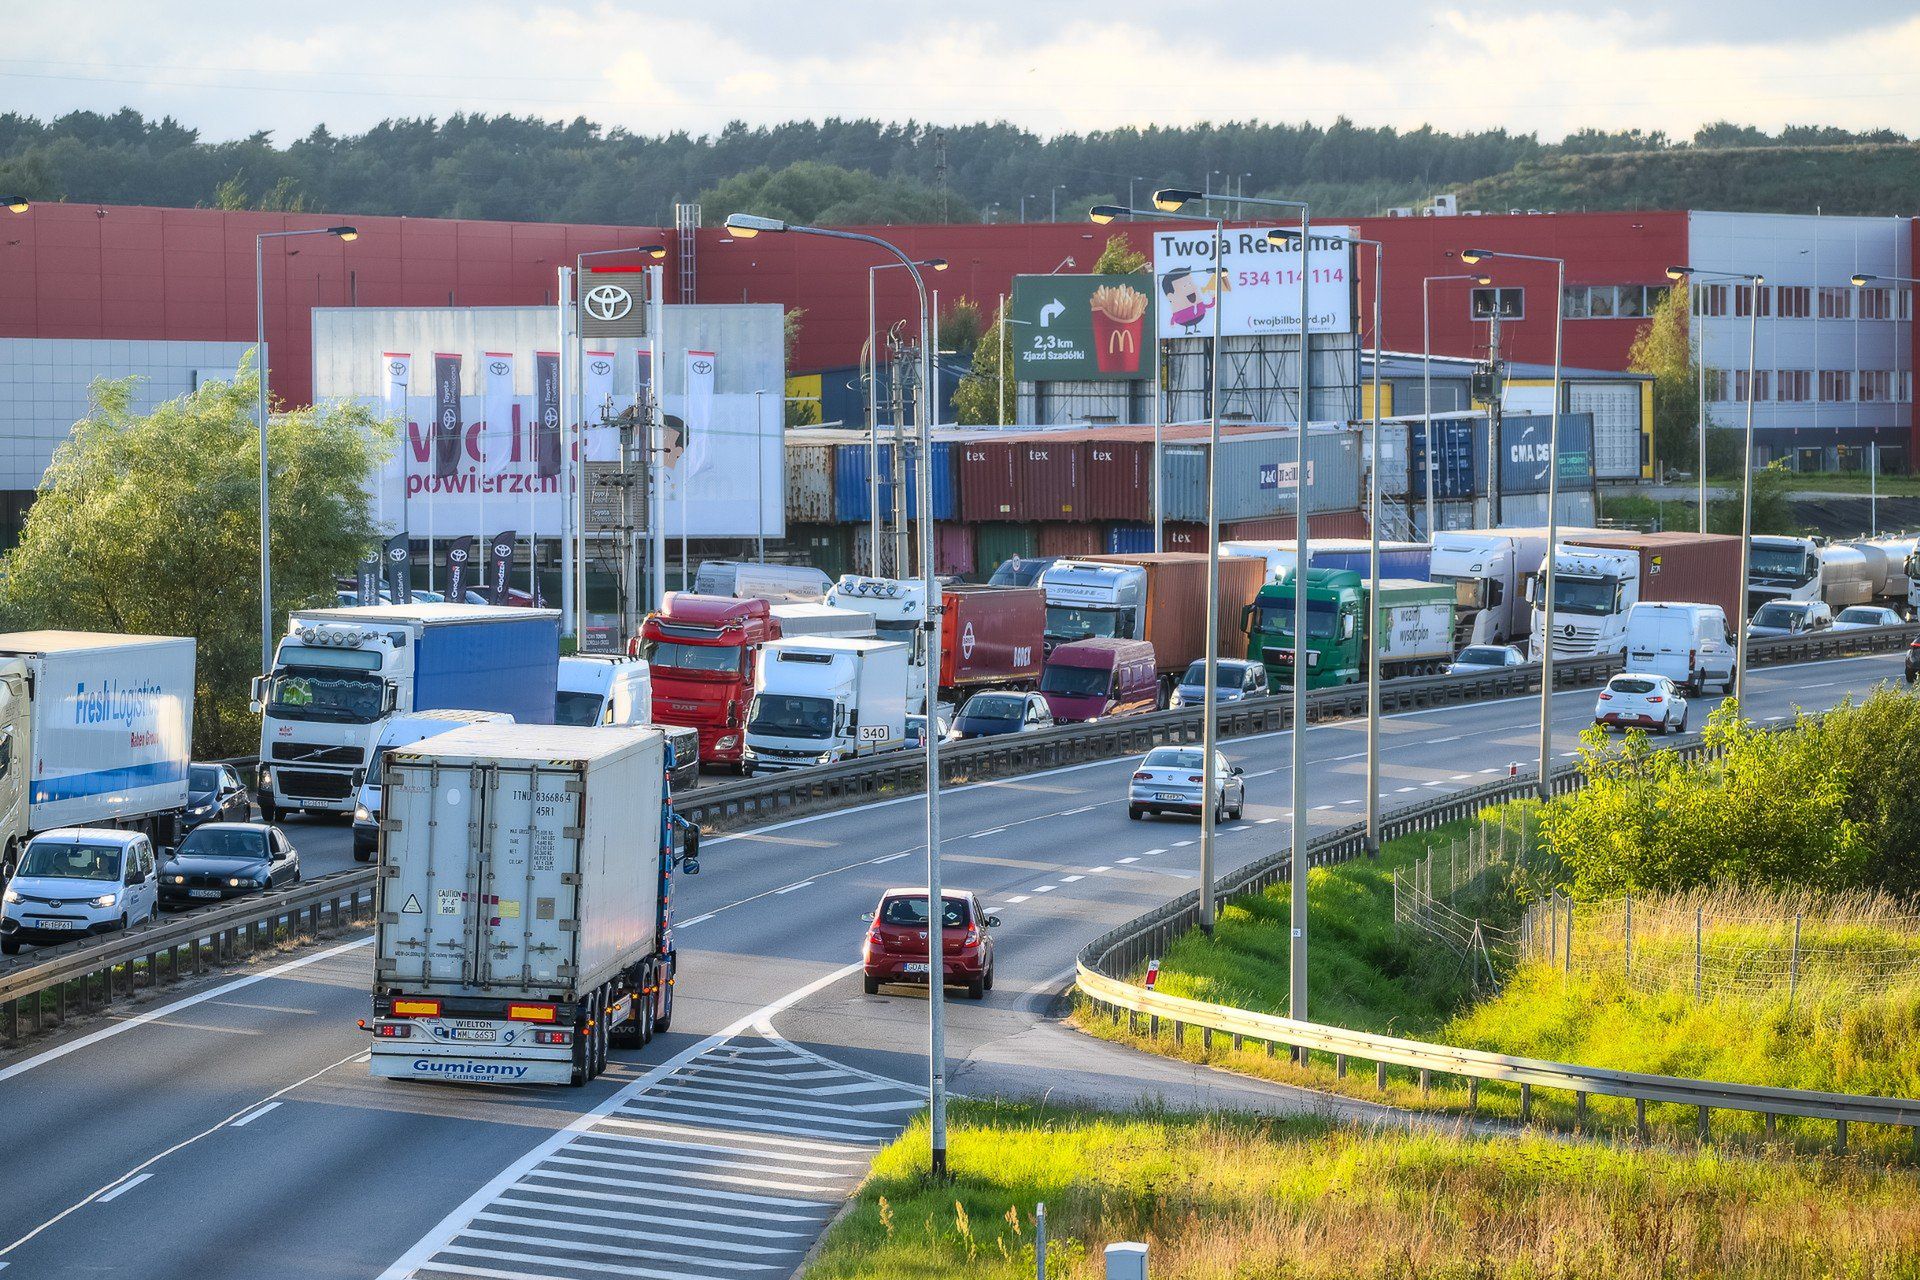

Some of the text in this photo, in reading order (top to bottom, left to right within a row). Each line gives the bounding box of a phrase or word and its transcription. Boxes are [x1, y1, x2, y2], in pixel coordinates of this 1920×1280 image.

[1160, 234, 1231, 261] Twoja
[1239, 268, 1344, 286] 534 114 114
[1034, 335, 1073, 350] 2,3 km
[1023, 350, 1085, 362] Zjazd Szadółki
[966, 451, 985, 461] tex
[1029, 450, 1049, 461] tex
[1093, 450, 1112, 461] tex
[1511, 443, 1553, 463] CMA CG
[1172, 532, 1191, 543] tex
[76, 680, 110, 724] Fresh
[672, 703, 698, 711] DAF
[863, 728, 885, 739] 340
[513, 791, 532, 801] TTNU
[536, 792, 564, 802] 836686
[536, 807, 554, 816] 45R1
[456, 1020, 492, 1029] WIELTON
[456, 1030, 470, 1039] WML
[413, 1059, 528, 1078] Gumienny
[444, 1073, 495, 1081] Transport
